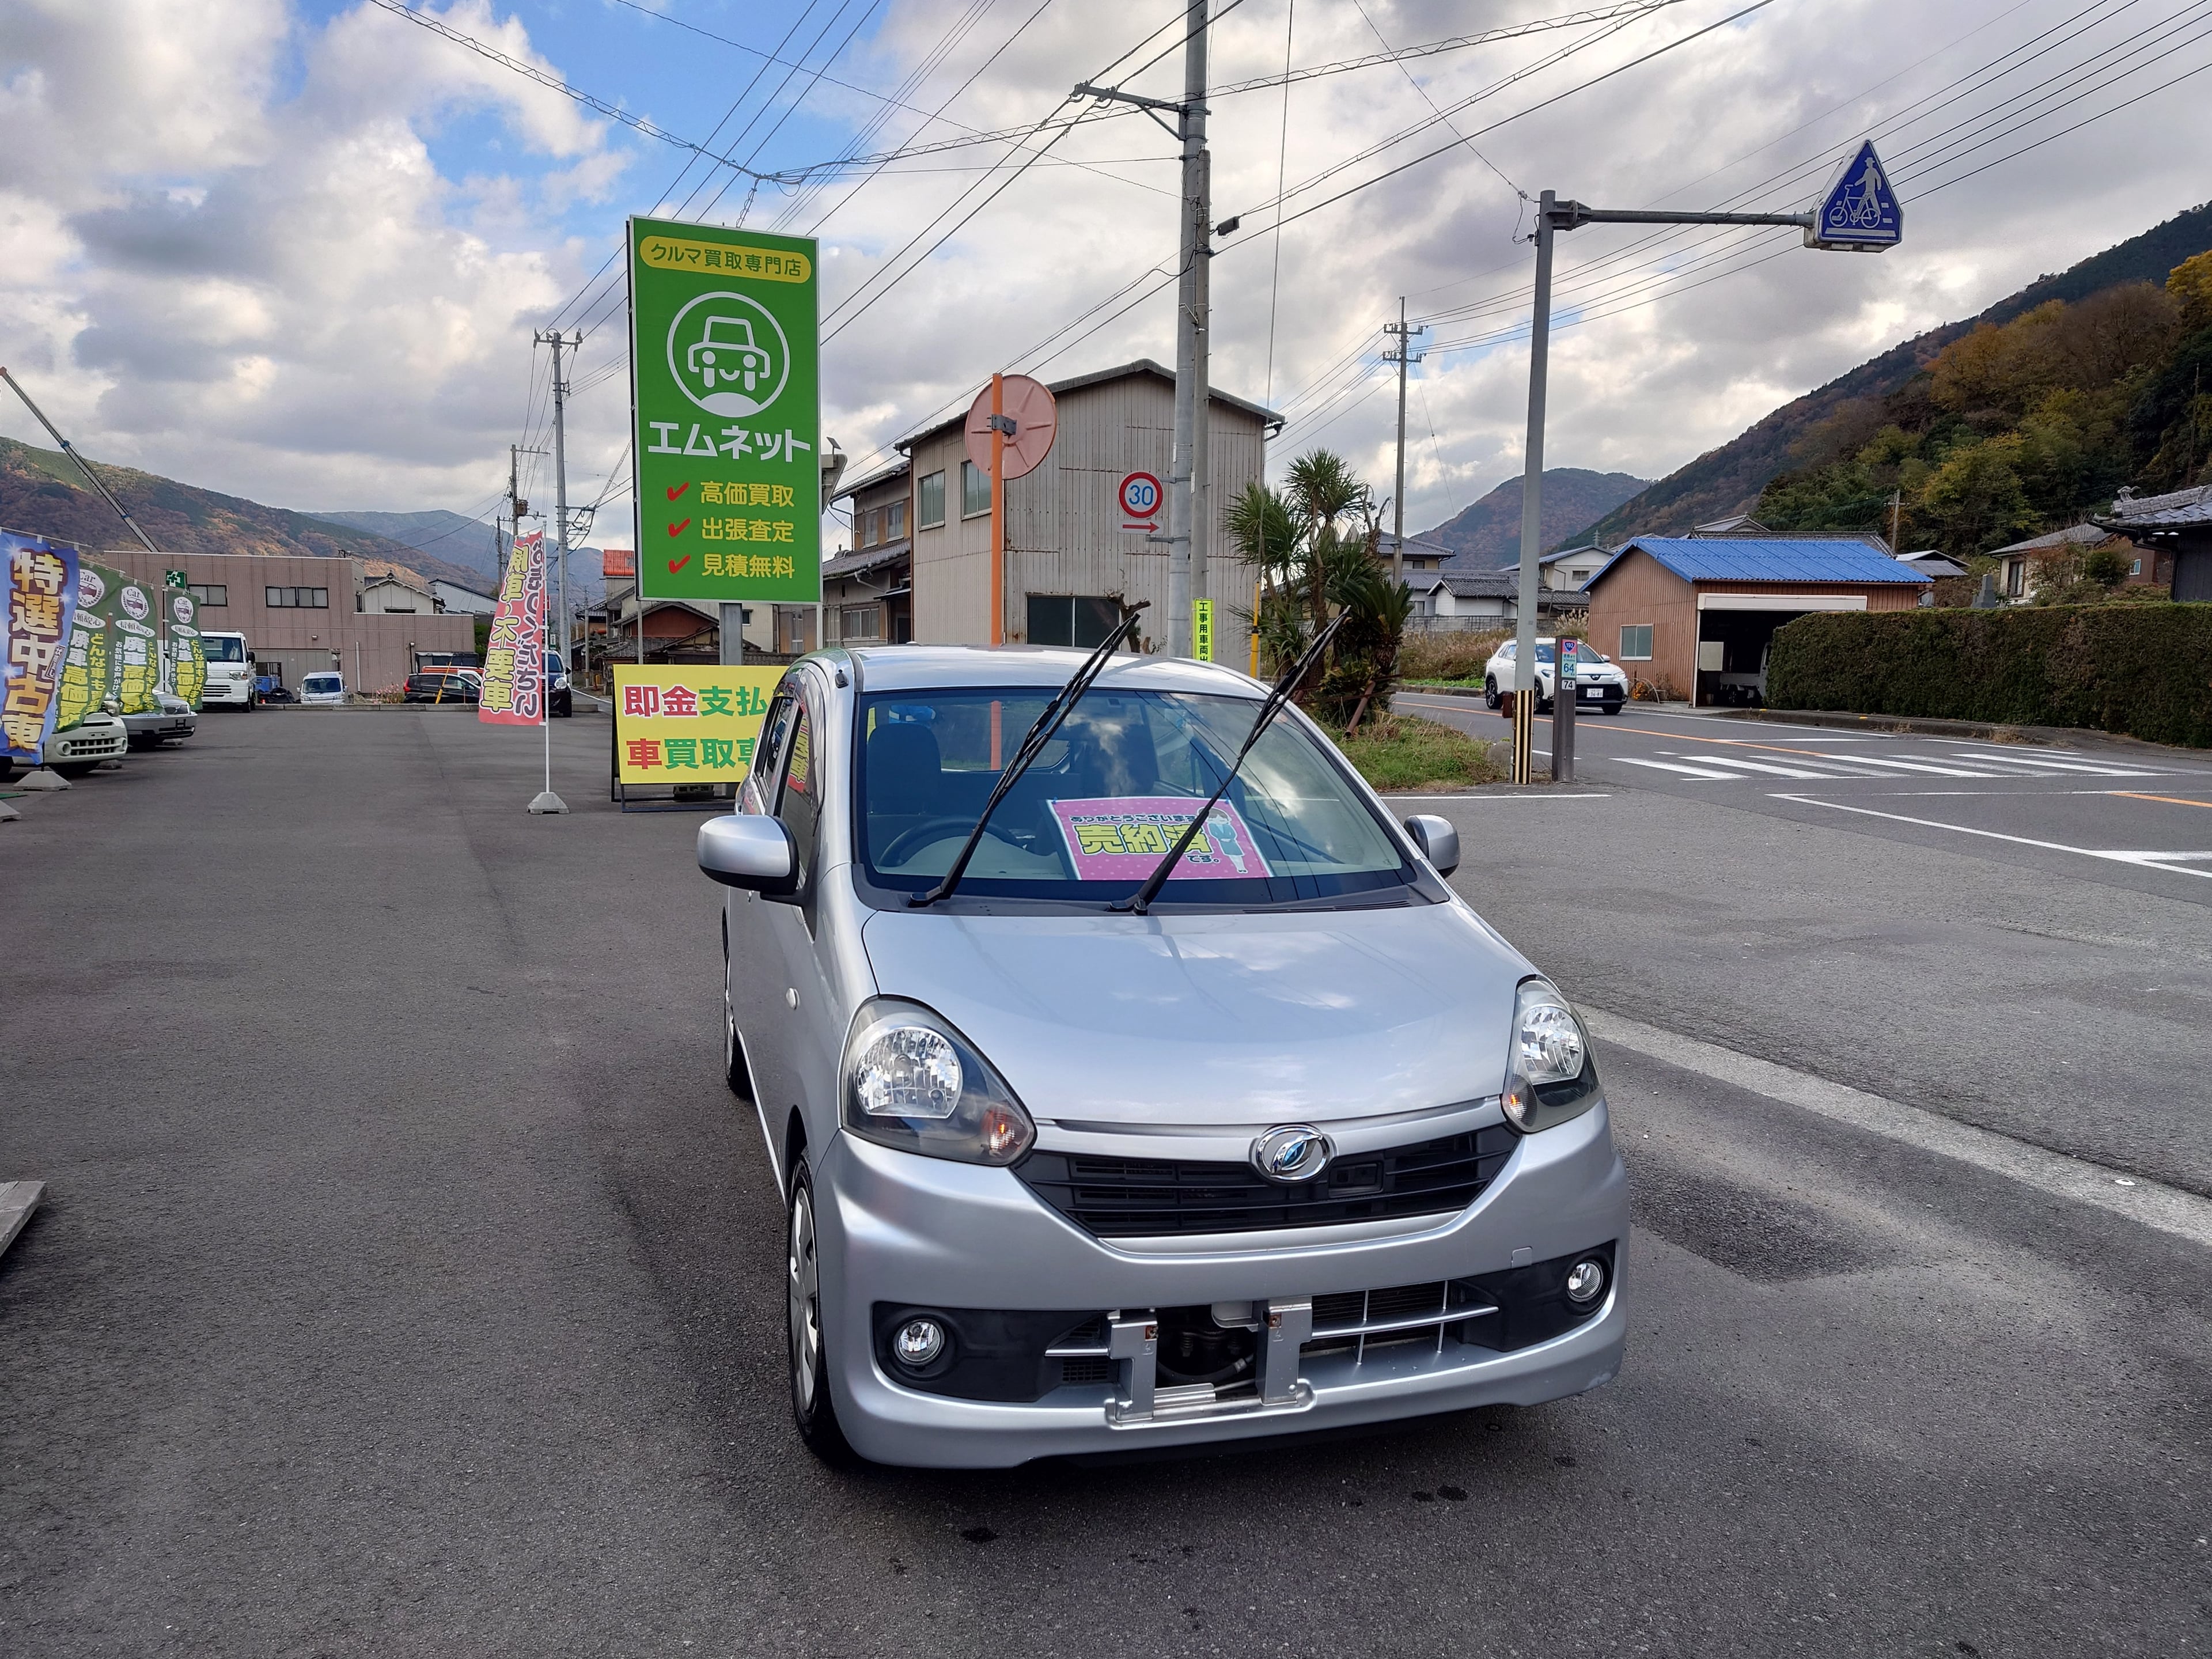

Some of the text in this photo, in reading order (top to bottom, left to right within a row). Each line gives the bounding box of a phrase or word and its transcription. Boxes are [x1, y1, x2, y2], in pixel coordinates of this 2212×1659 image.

[651, 243, 801, 276] クルマ買取専門店
[648, 421, 810, 462] エムネット
[700, 481, 794, 507] 高価買取
[1128, 484, 1153, 506] 30
[702, 517, 794, 542] 出張査定
[80, 571, 96, 583] Car
[702, 554, 795, 578] 見積無料
[127, 589, 140, 599] Car
[2, 551, 64, 751] 特選中古車
[1563, 663, 1574, 673] 64
[1564, 681, 1573, 689] 74
[624, 685, 775, 717] 即金支払
[1074, 824, 1213, 854] 売約済
[1187, 855, 1219, 863] です。
